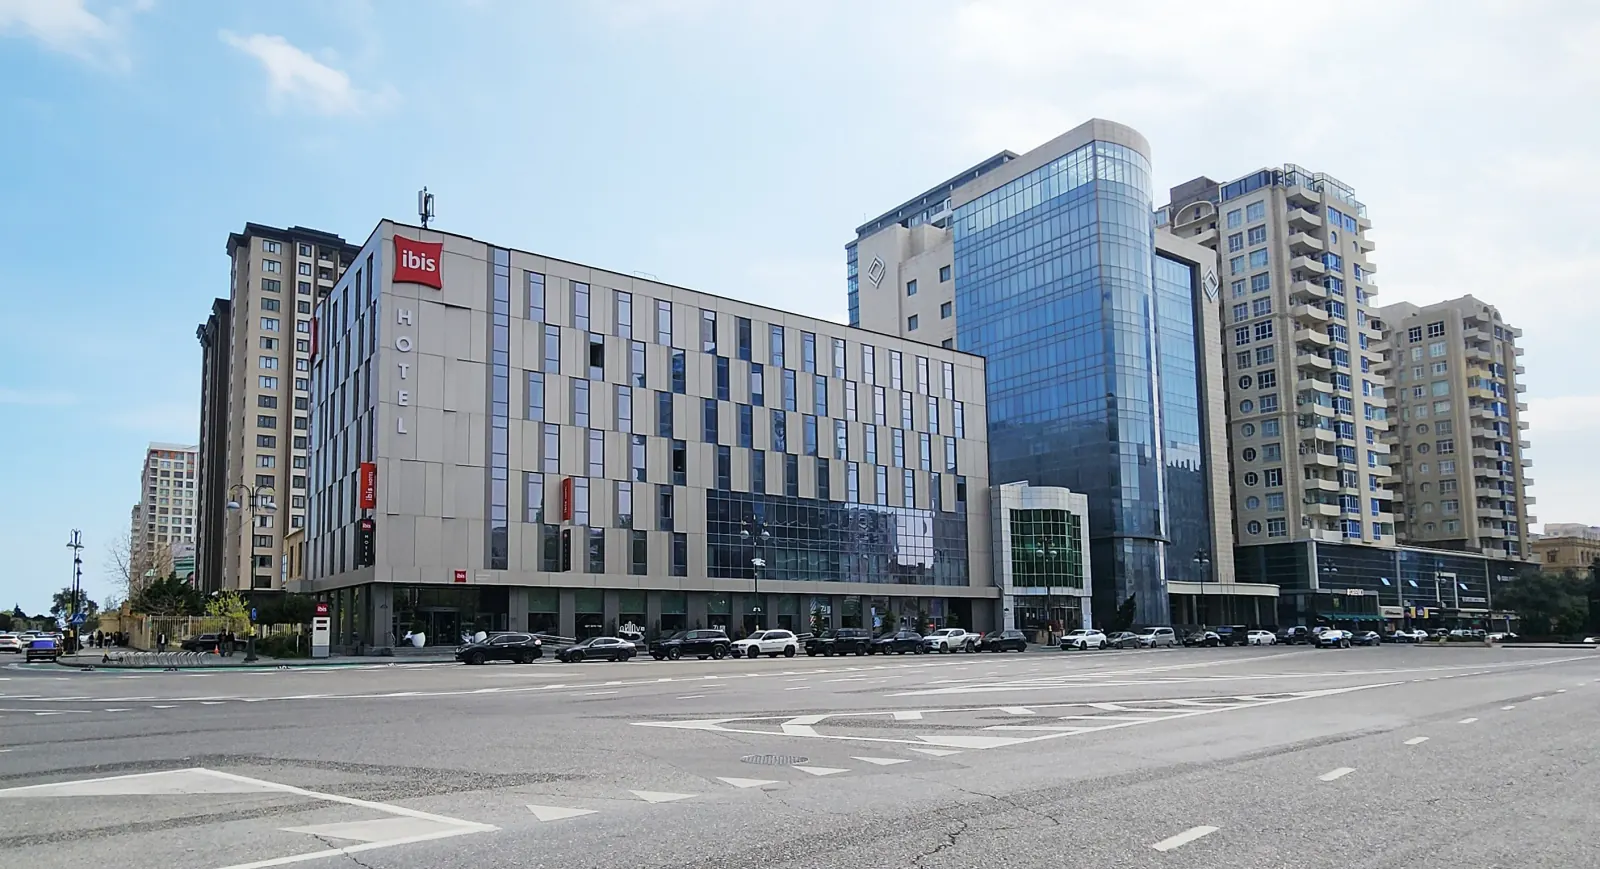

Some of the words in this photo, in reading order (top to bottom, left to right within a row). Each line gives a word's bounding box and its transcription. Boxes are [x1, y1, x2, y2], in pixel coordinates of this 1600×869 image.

[403, 250, 436, 272] ibis
[395, 309, 412, 434] HOTEL
[365, 487, 373, 501] ibis
[317, 605, 328, 613] ibis
